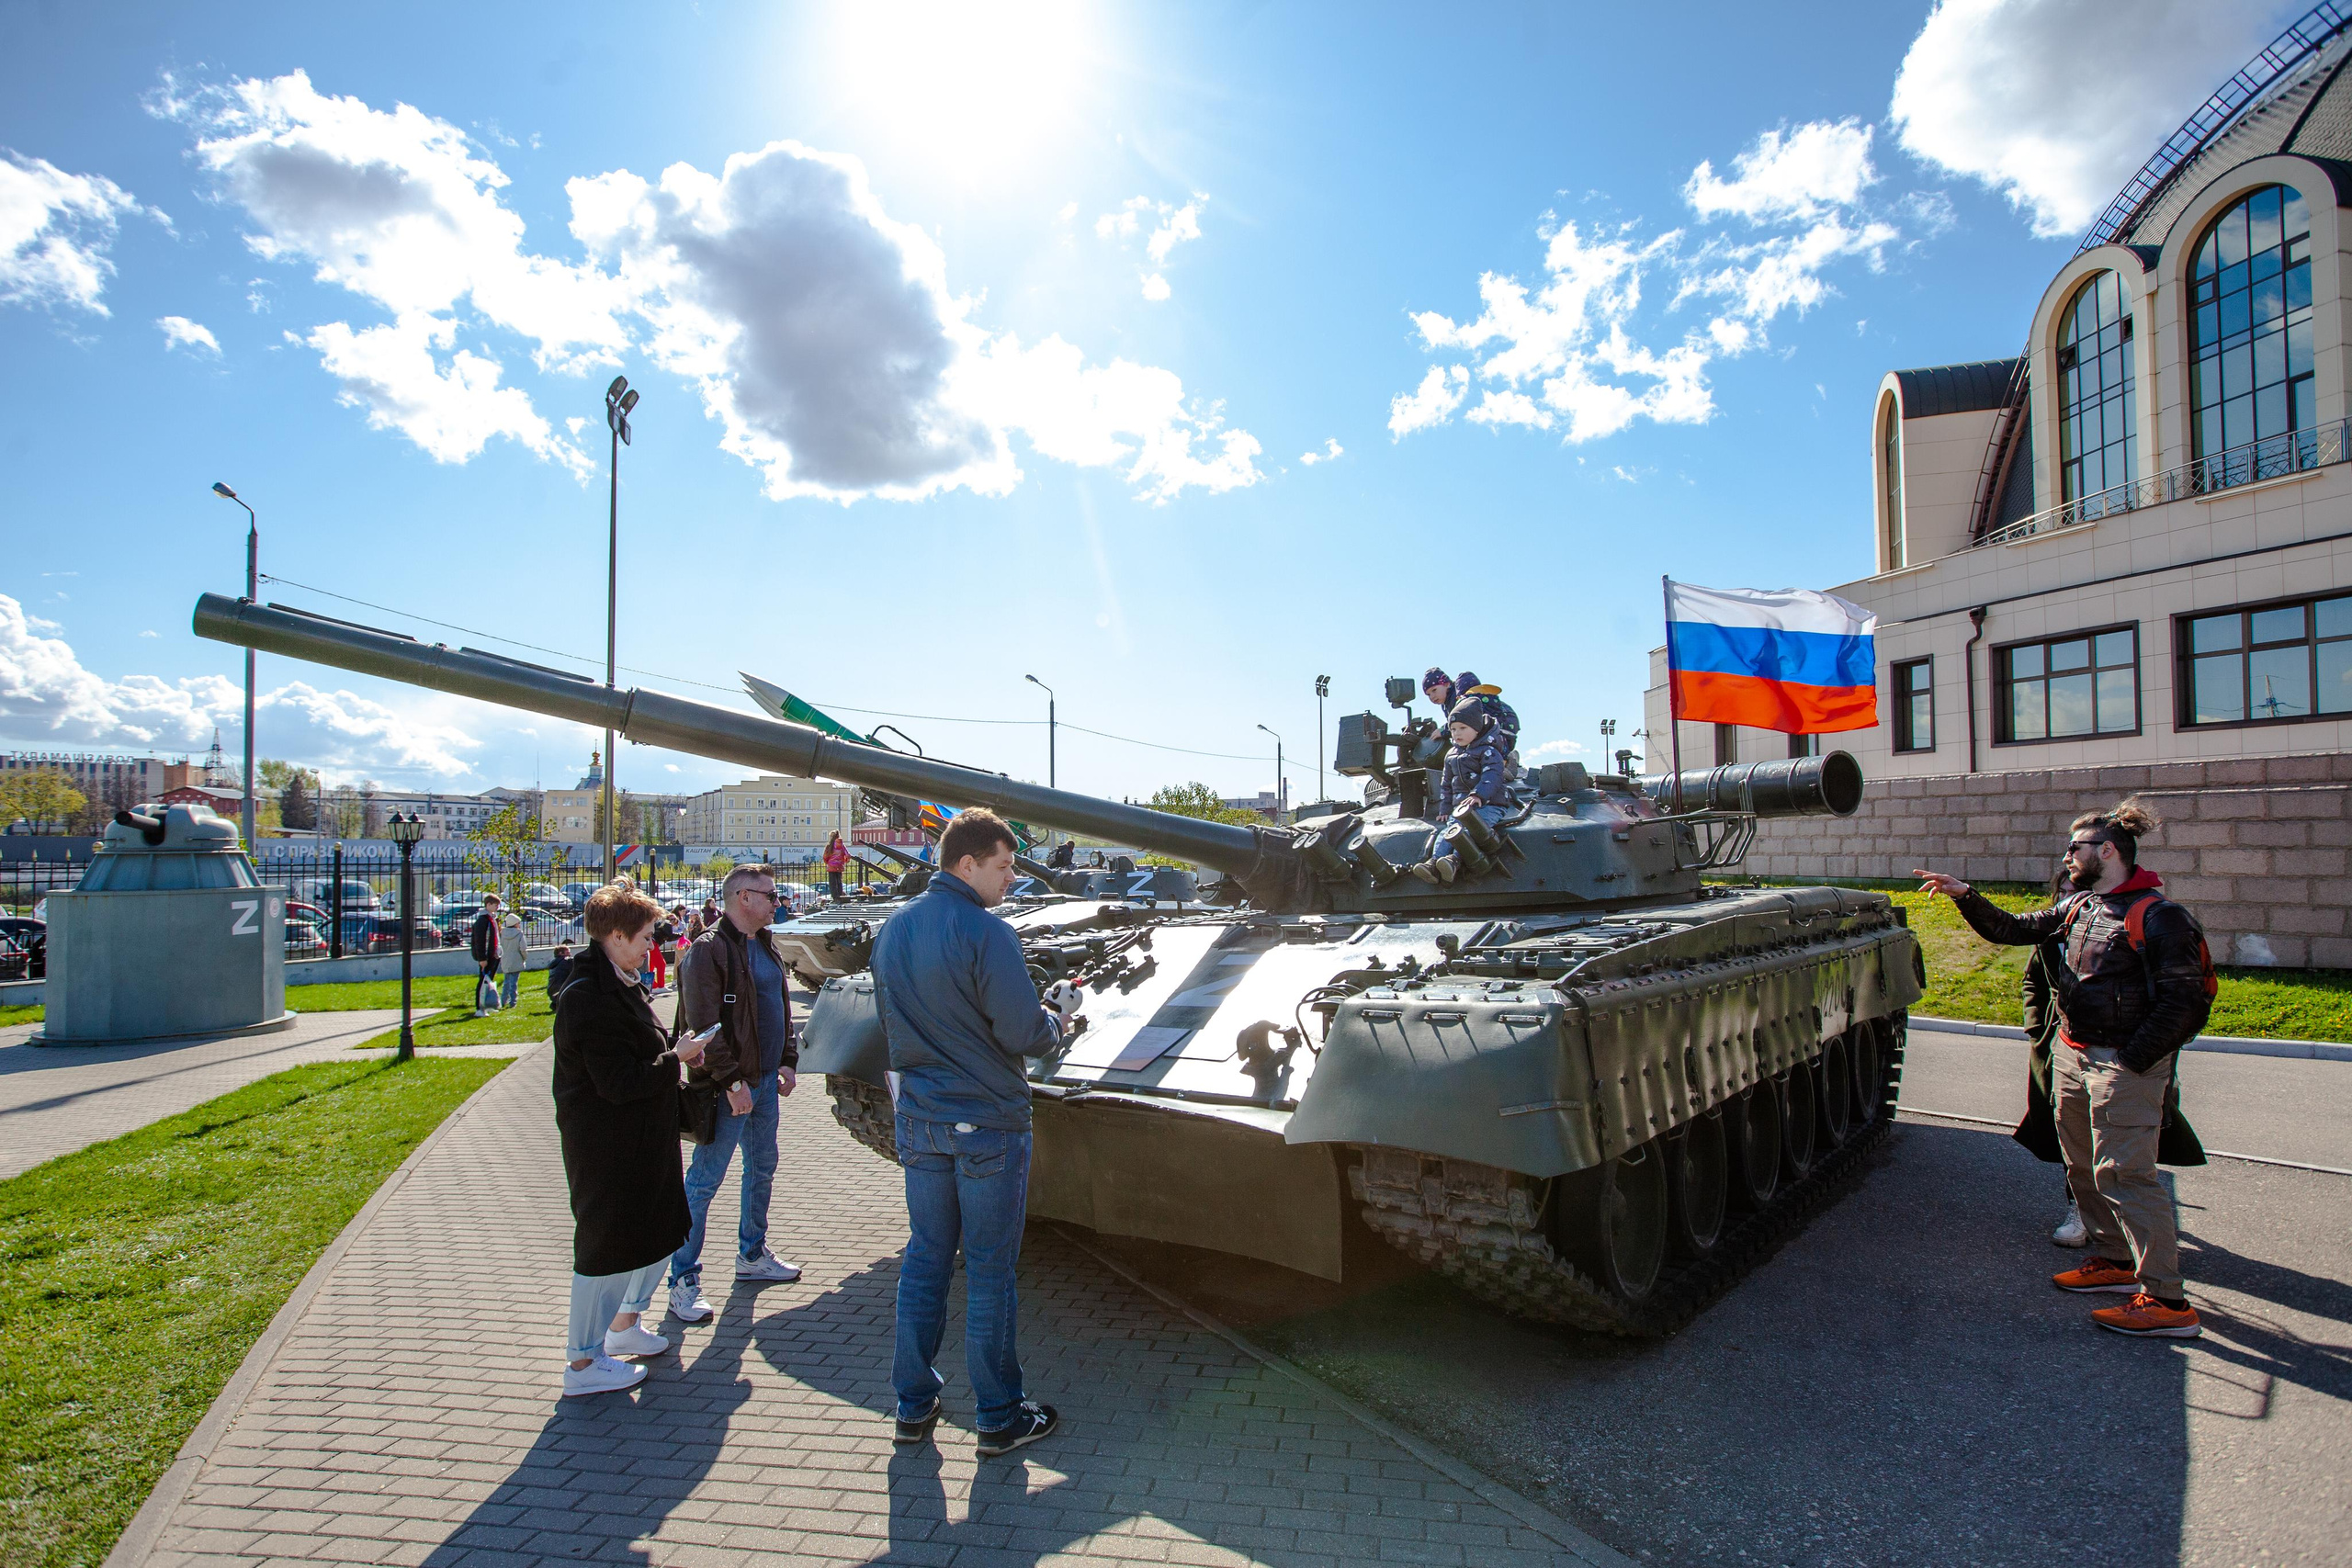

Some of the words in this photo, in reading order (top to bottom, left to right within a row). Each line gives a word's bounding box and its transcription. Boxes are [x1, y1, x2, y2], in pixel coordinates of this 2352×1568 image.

[275, 845, 285, 858] С
[395, 844, 469, 859] ВЛИКОЙ
[1013, 878, 1035, 896] Z
[1126, 872, 1155, 897] Z
[232, 899, 259, 936] Z
